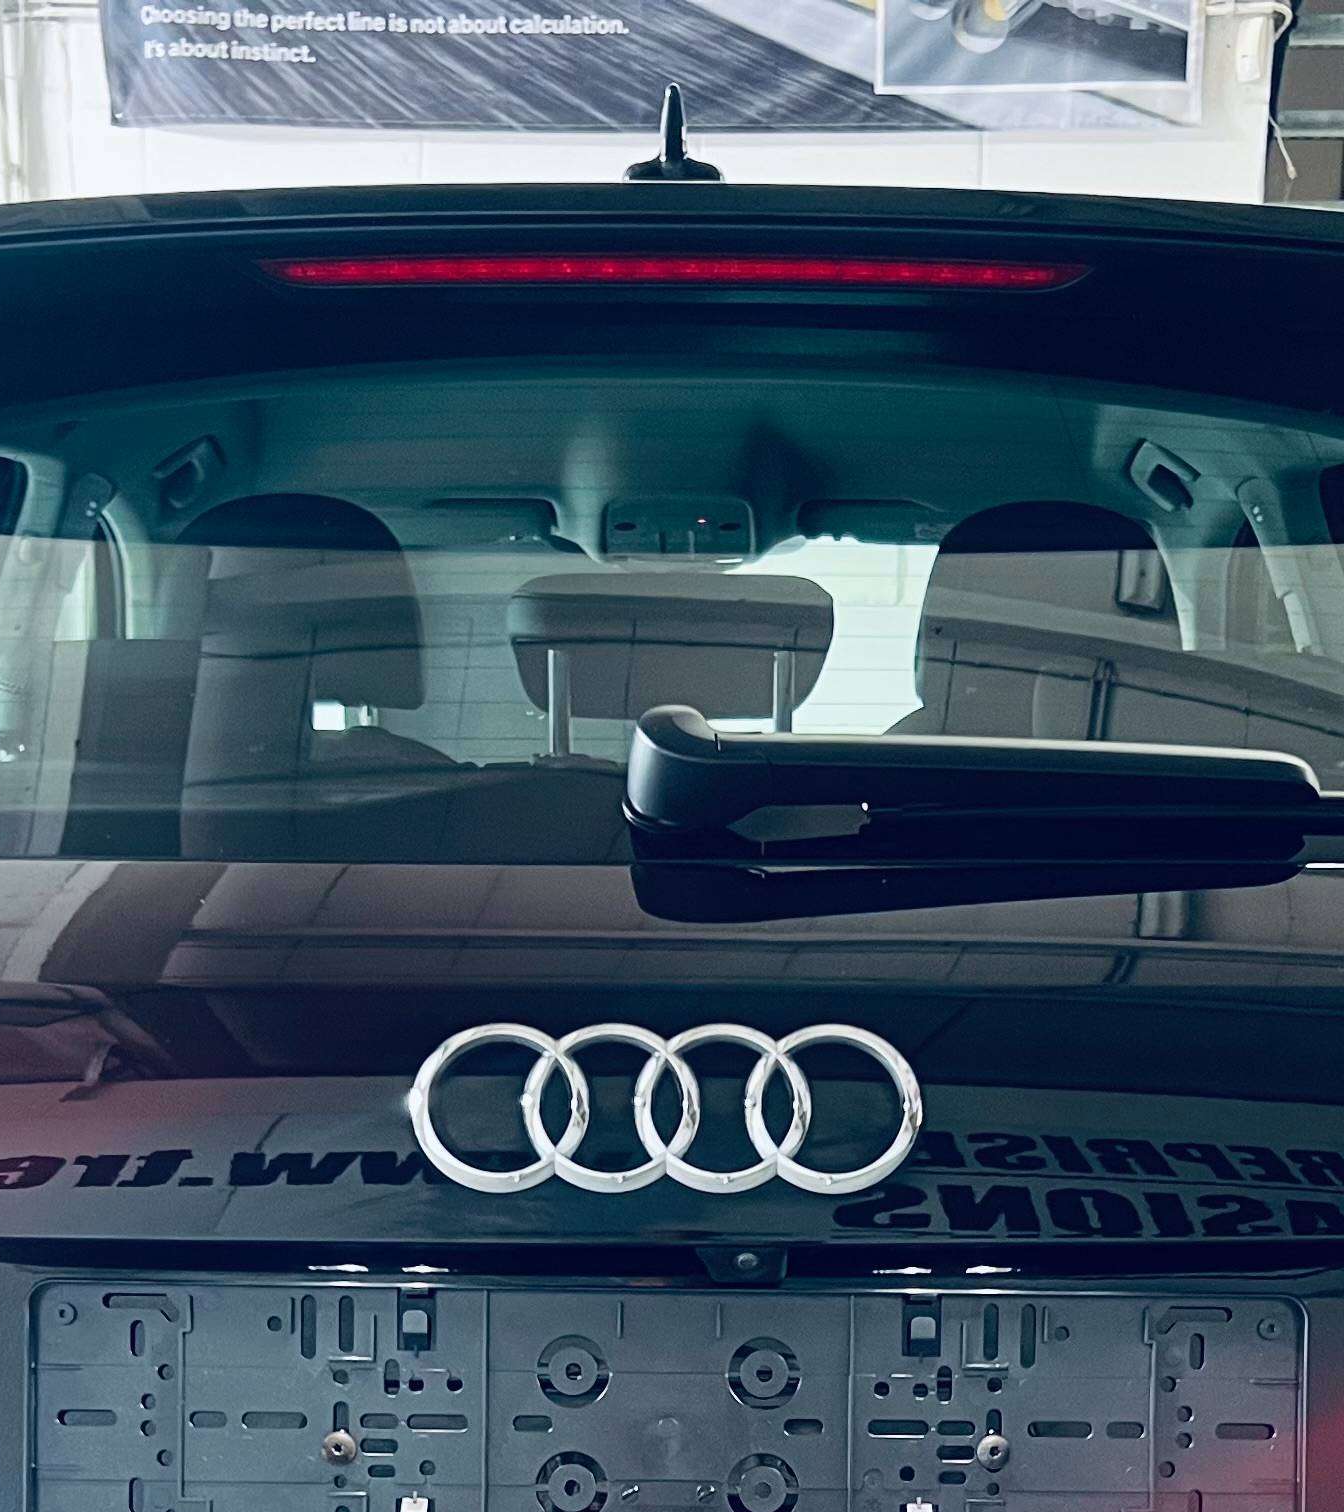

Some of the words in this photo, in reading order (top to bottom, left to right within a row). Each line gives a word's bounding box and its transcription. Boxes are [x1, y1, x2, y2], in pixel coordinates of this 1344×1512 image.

[140, 5, 232, 31] Choosing
[233, 8, 269, 29] the
[270, 10, 346, 33] perfect
[347, 11, 385, 32] line
[388, 14, 407, 33] is
[410, 15, 446, 34] not
[447, 14, 506, 34] about
[509, 14, 629, 35] calculation.
[168, 38, 229, 60] about
[231, 41, 316, 63] instinct.
